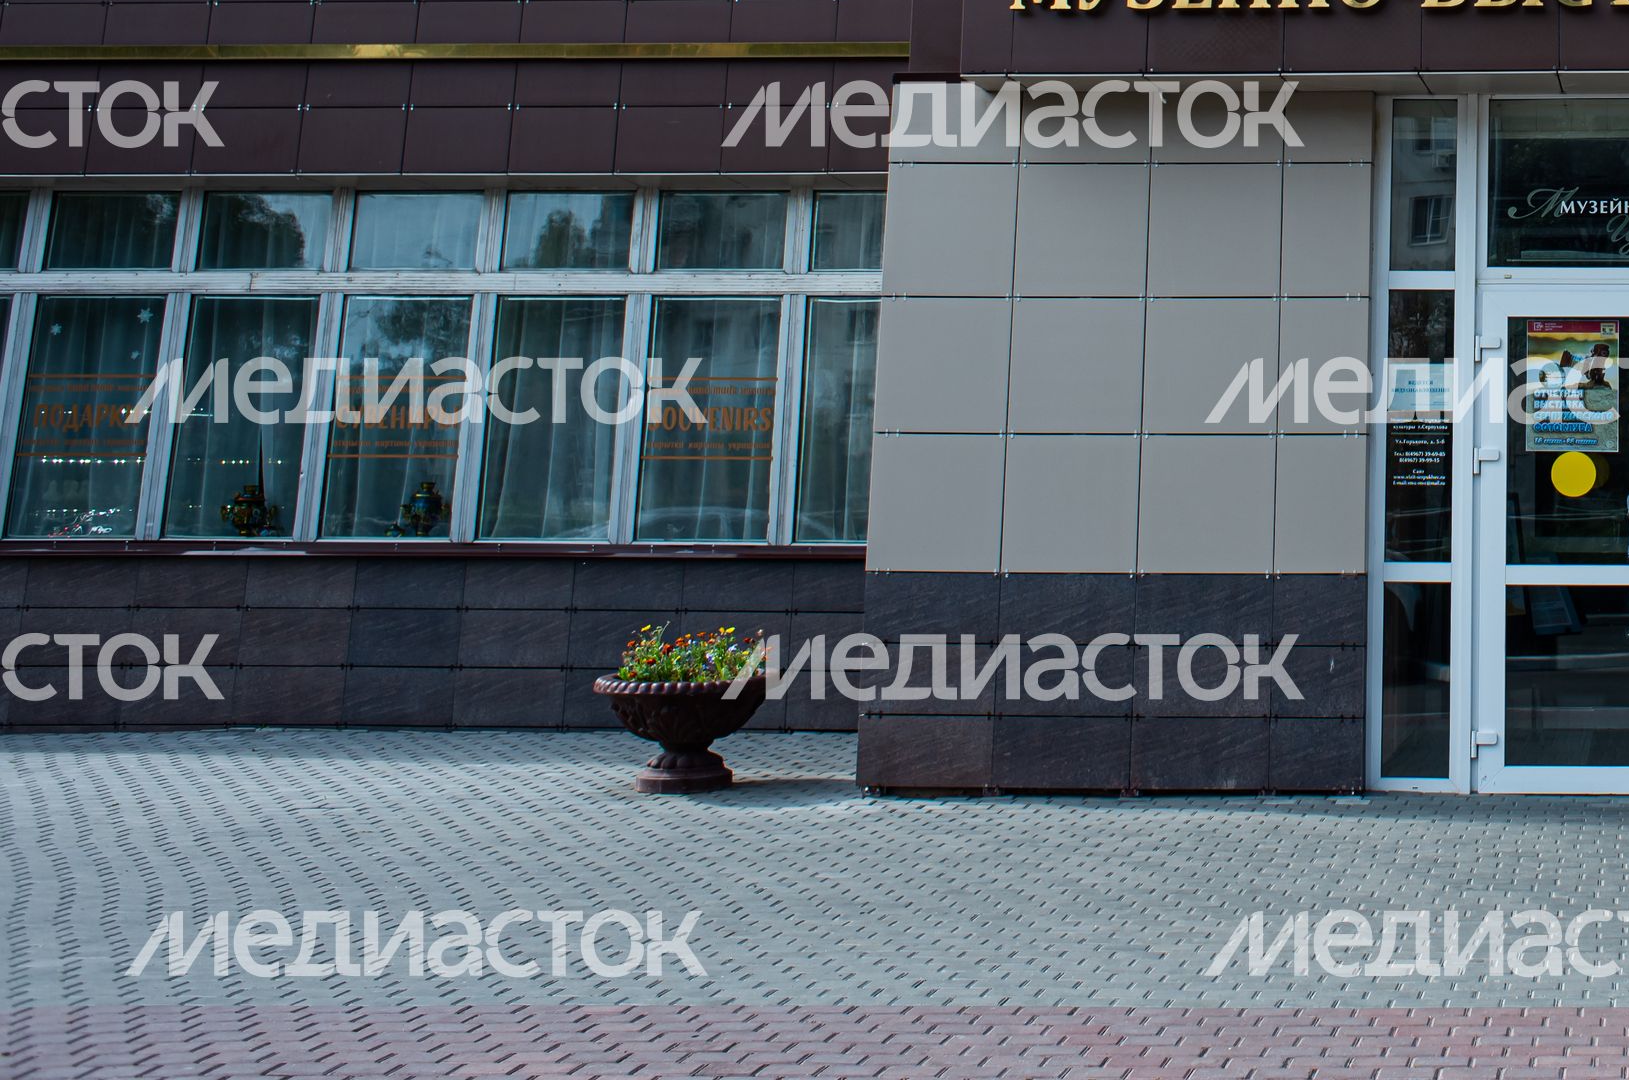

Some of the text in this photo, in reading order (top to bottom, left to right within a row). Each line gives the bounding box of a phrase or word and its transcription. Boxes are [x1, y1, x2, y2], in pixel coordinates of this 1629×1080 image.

[1533, 399, 1585, 409] ВЫСТАВКА
[648, 406, 773, 432] SOUVENIRS
[1533, 422, 1593, 432] ФОТОКЛУБА
